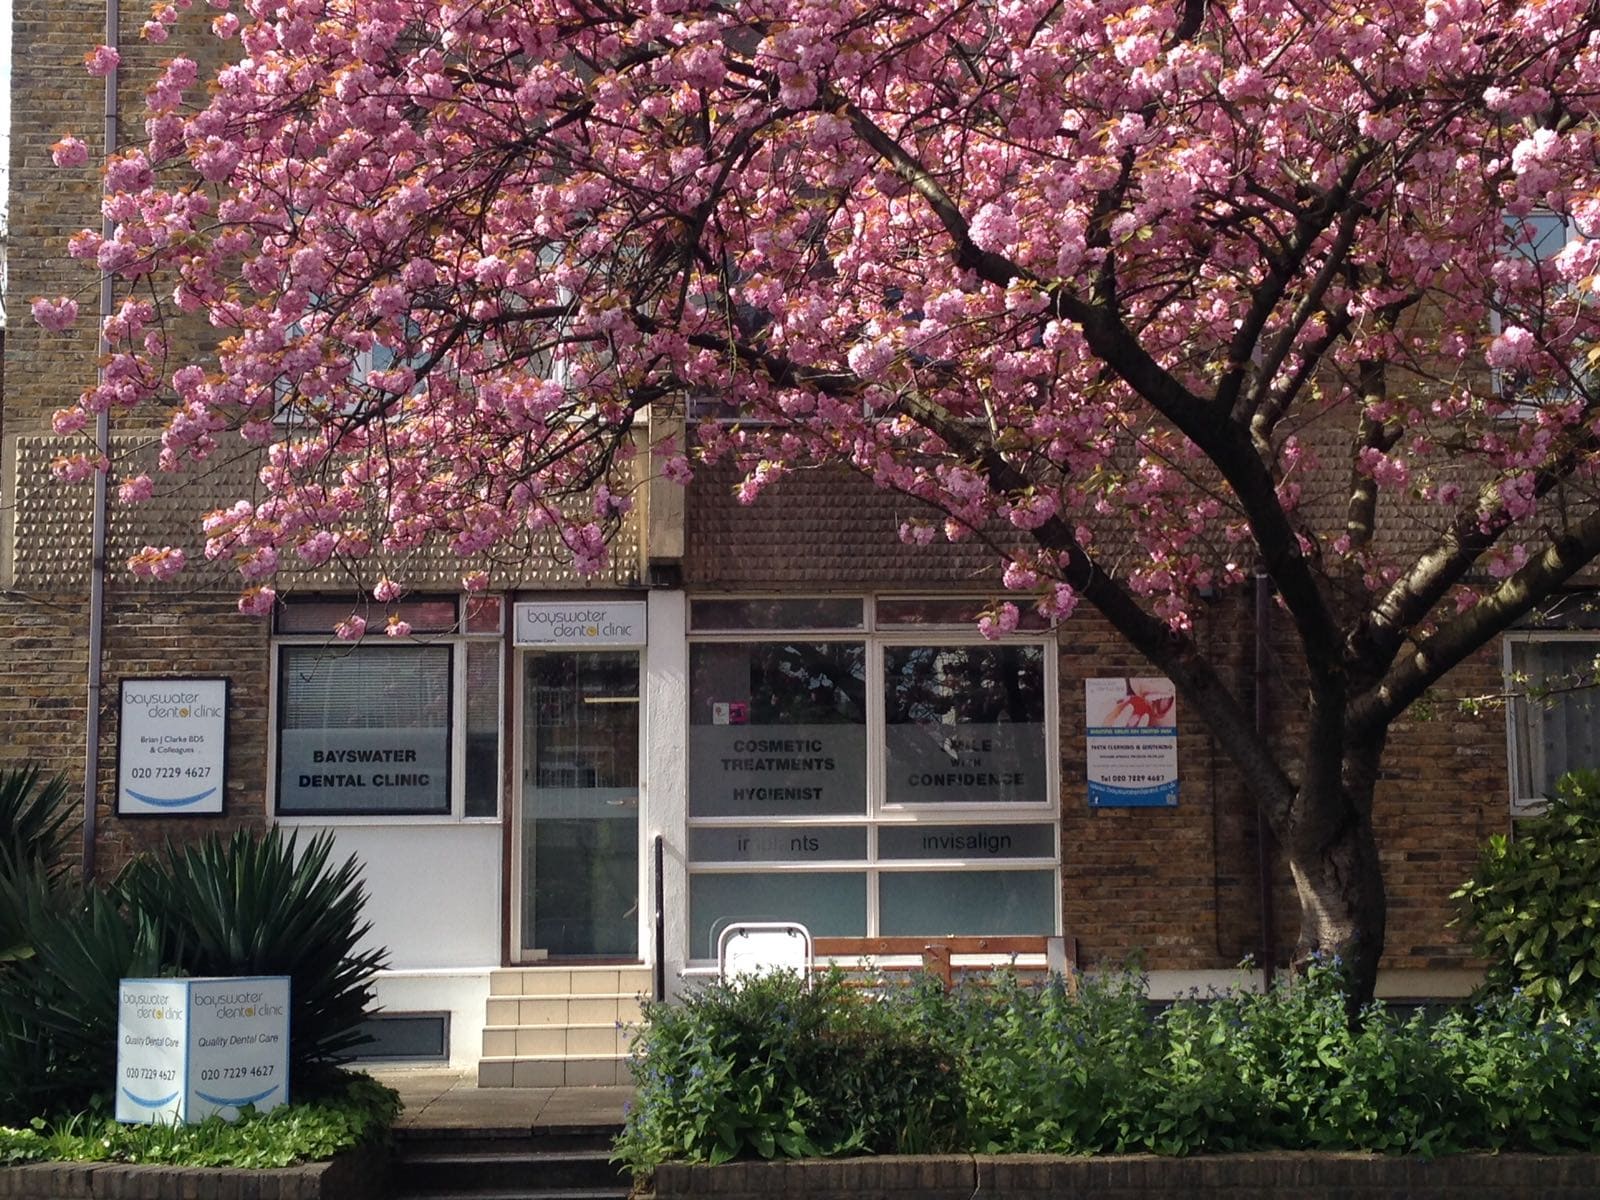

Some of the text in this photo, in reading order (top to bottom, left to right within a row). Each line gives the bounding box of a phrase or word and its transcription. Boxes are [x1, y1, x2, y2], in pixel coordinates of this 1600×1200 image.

[527, 609, 607, 626] bayswater
[553, 622, 632, 637] dental clinic
[125, 691, 200, 707] bayswater
[148, 704, 222, 718] dental clinic
[157, 747, 194, 755] Colleagues
[733, 740, 822, 752] COSMETIC
[313, 750, 416, 763] BAYSWATER
[722, 758, 835, 771] TREATMENTS
[132, 767, 211, 778] 020 7229 4627
[908, 773, 1024, 786] CONFIDENCE
[299, 774, 430, 787] DENTAL CLINIC
[733, 787, 823, 800] HYGIENIST
[923, 833, 1012, 852] invisalign
[123, 991, 168, 1008] bayswater
[195, 992, 263, 1011] bayswater
[137, 1007, 183, 1021] dental clinic
[216, 1003, 283, 1019] dental clinic
[125, 1035, 180, 1048] Quality Dental Care
[198, 1034, 278, 1049] Quality Dental Care
[126, 1067, 175, 1081] 020 7229 4627
[201, 1066, 274, 1080] 020 7229 4627
